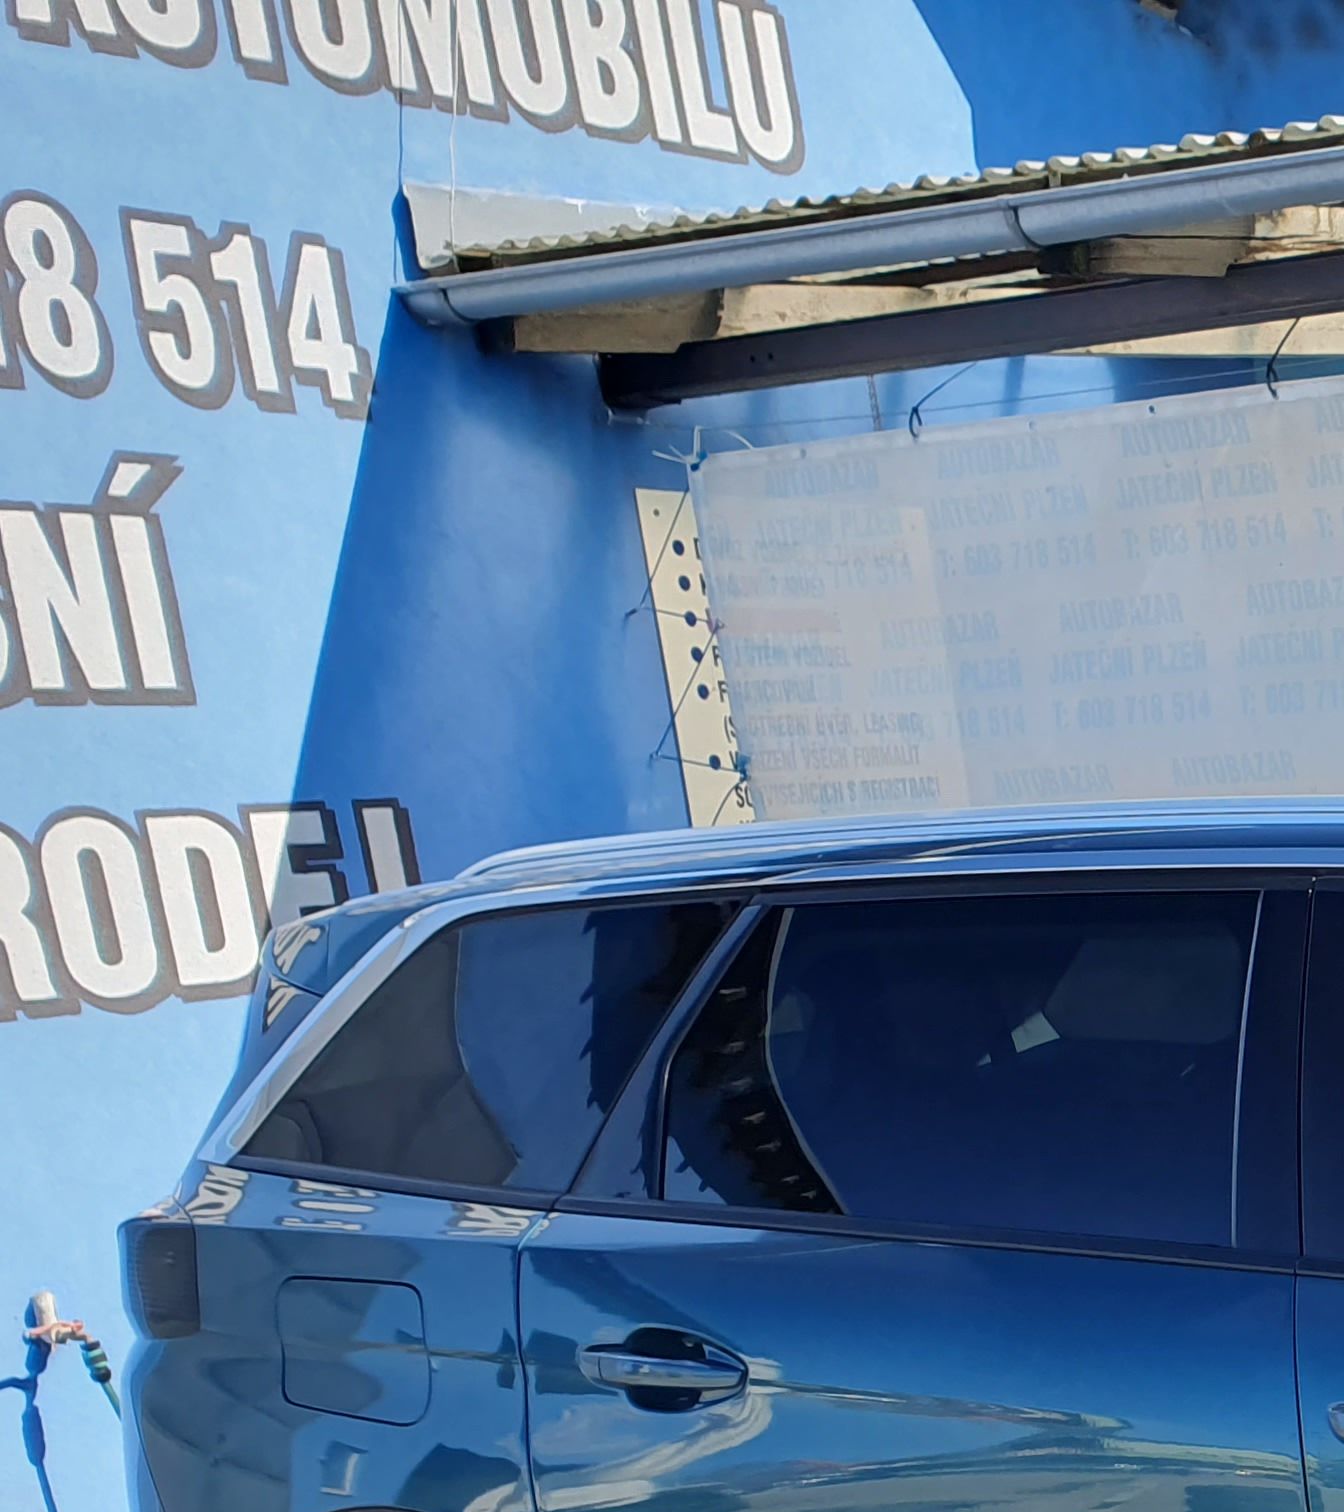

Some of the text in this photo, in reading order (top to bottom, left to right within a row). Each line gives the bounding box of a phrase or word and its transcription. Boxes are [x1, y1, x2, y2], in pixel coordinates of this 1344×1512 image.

[3, 0, 805, 174] OMOBILU
[0, 190, 372, 420] 8 514
[0, 450, 197, 706] NÍ
[1059, 593, 1183, 632] AUTOBAZAR
